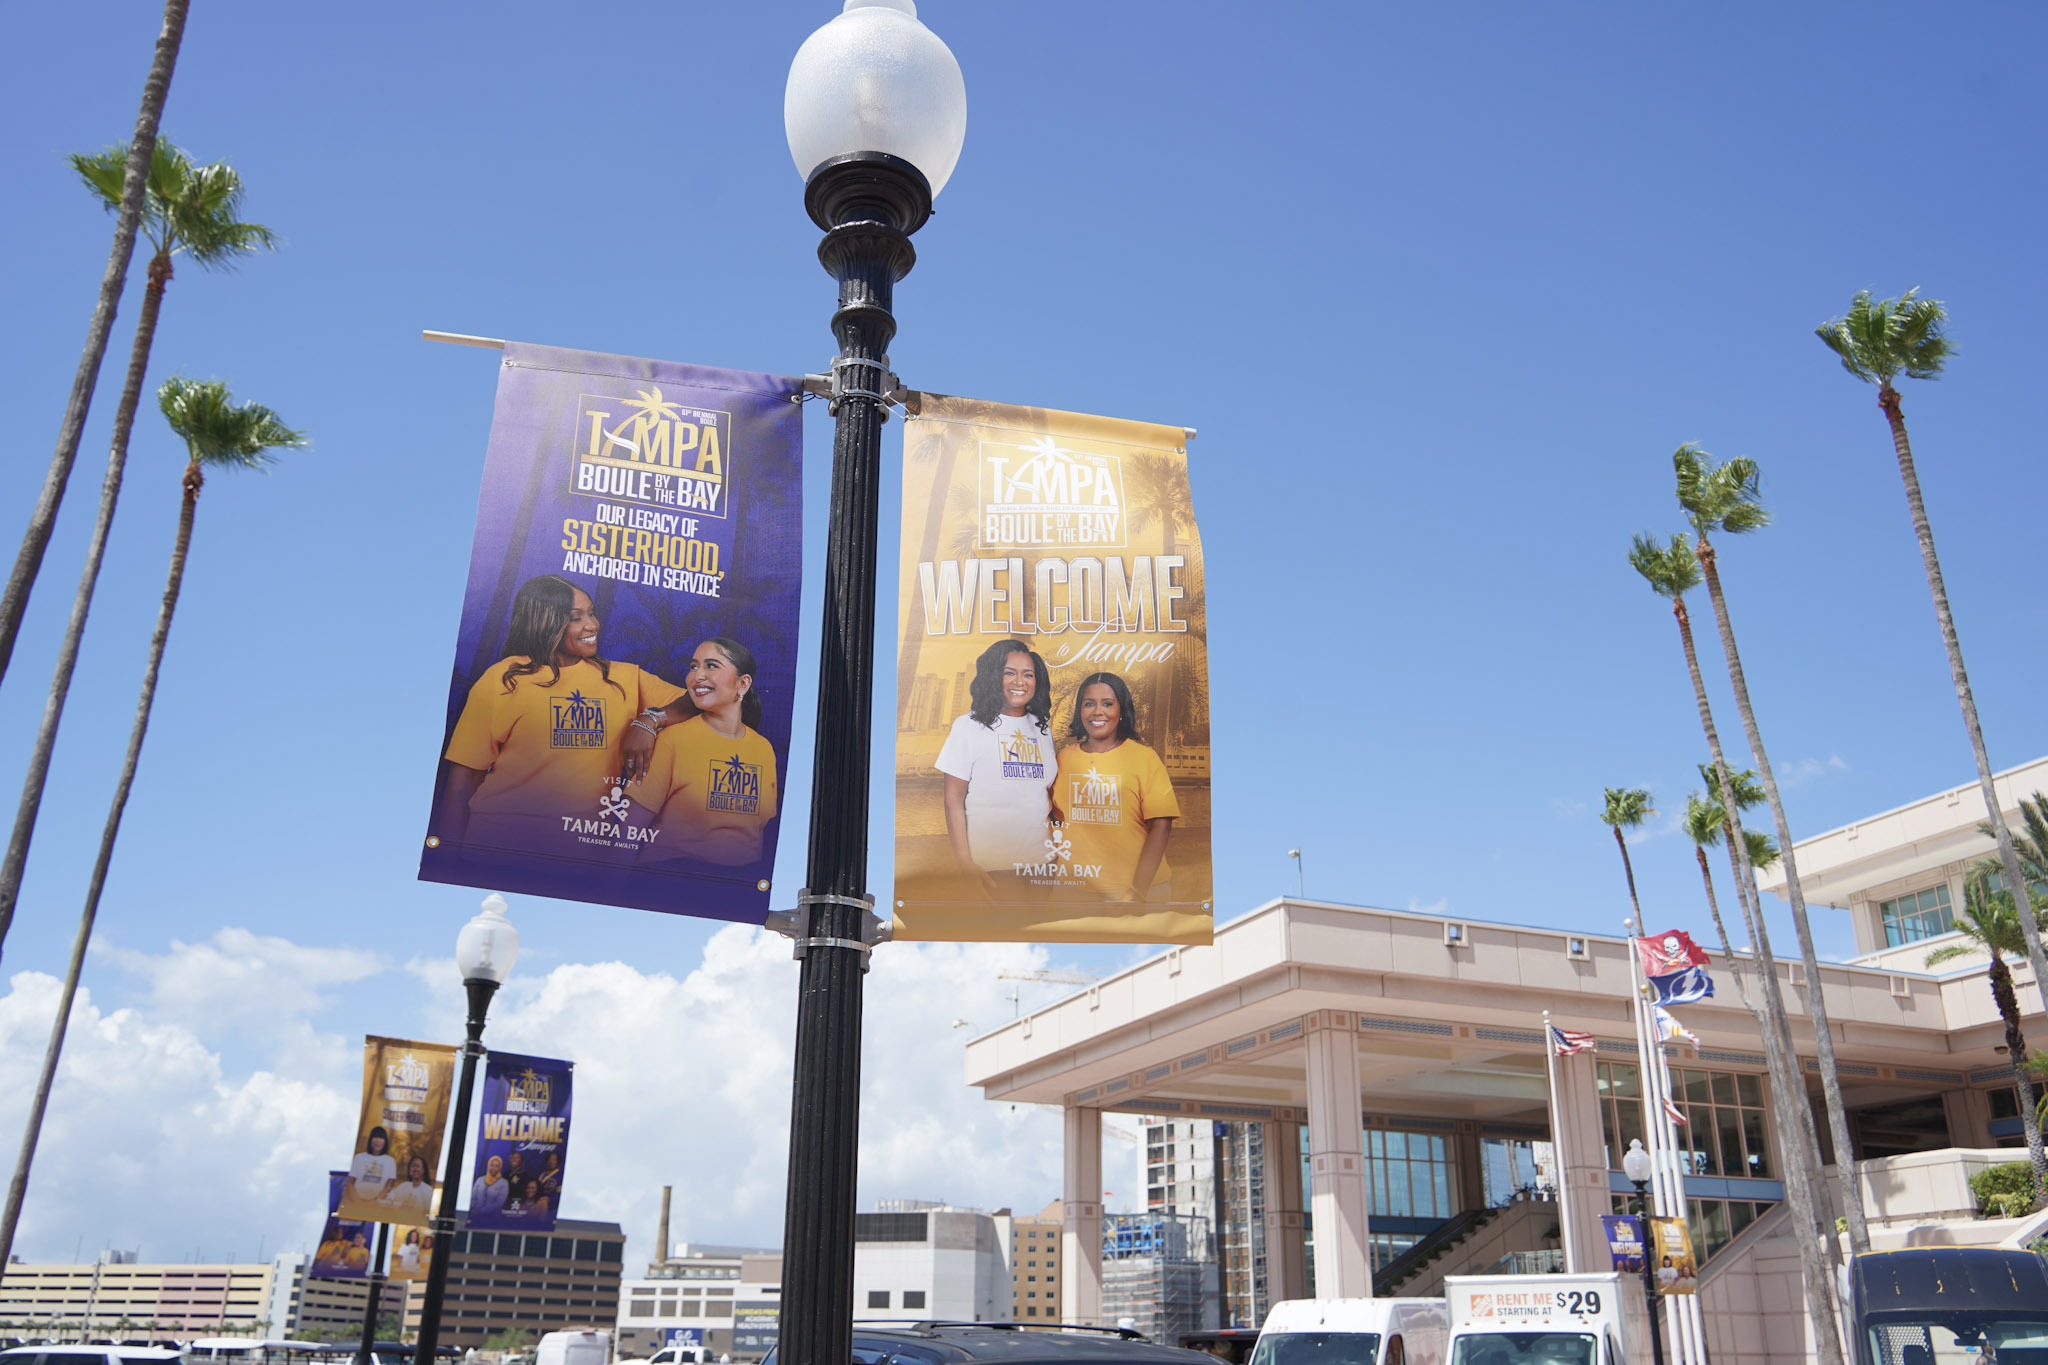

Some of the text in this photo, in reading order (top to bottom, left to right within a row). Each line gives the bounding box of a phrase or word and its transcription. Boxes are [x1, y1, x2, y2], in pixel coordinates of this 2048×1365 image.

[586, 408, 722, 475] TAMPA
[578, 463, 722, 512] BOULE BY THE BAY
[986, 456, 1118, 506] TAMPA
[596, 503, 699, 538] OUR LEGACY OF
[986, 513, 1120, 544] BOULE BY THE BAY
[561, 518, 725, 581] SISTERHOOD,
[562, 551, 721, 598] ANCHORED IN SERVICE
[919, 555, 1187, 636] WELCOME
[1046, 617, 1175, 672] Tampa
[553, 704, 604, 729] TAMPA
[554, 734, 580, 746] BOULE
[589, 734, 604, 747] BAY
[1001, 741, 1043, 764] TAMPA
[603, 776, 634, 787] VISIT
[712, 768, 758, 796] TAMPA
[1003, 766, 1025, 778] BOULE
[1032, 766, 1044, 779] BAY
[710, 796, 734, 811] BOULE
[743, 799, 758, 812] BAY
[1072, 782, 1119, 806] TAMPA
[1044, 821, 1071, 829] VISIT
[1072, 808, 1096, 821] BOULE
[1104, 809, 1119, 823] BAY
[562, 816, 660, 843] TAMPA BAY
[578, 836, 639, 850] TREASURE AWAITS
[1013, 863, 1102, 878] TAMPA BAY
[484, 1114, 566, 1143] WELCOME
[1610, 1242, 1644, 1254] WELCOME
[1496, 1293, 1552, 1305] RENT ME
[1556, 1291, 1601, 1314] $29
[1497, 1307, 1552, 1316] STARTING AT
